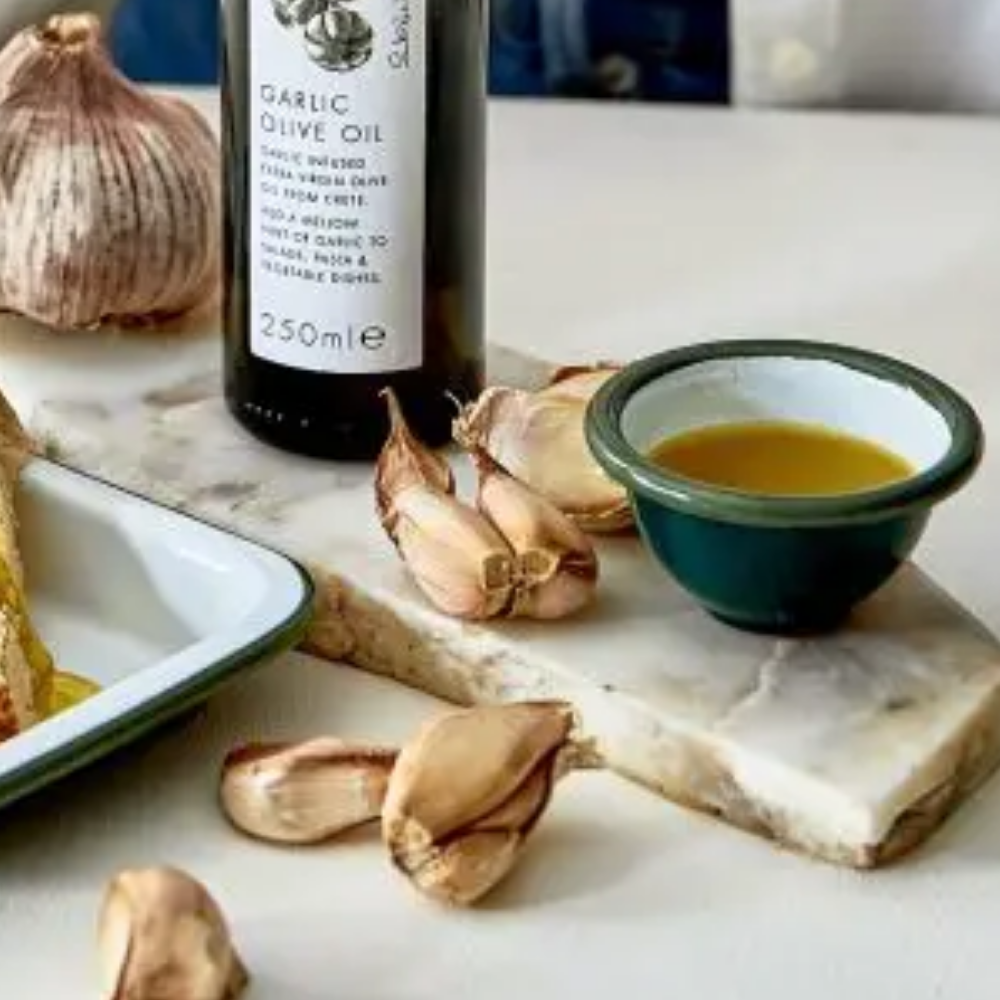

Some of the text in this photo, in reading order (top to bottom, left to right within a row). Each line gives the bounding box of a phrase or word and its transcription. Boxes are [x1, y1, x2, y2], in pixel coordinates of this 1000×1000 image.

[260, 85, 350, 115] GARLIC
[260, 112, 383, 143] OLIVE OIL
